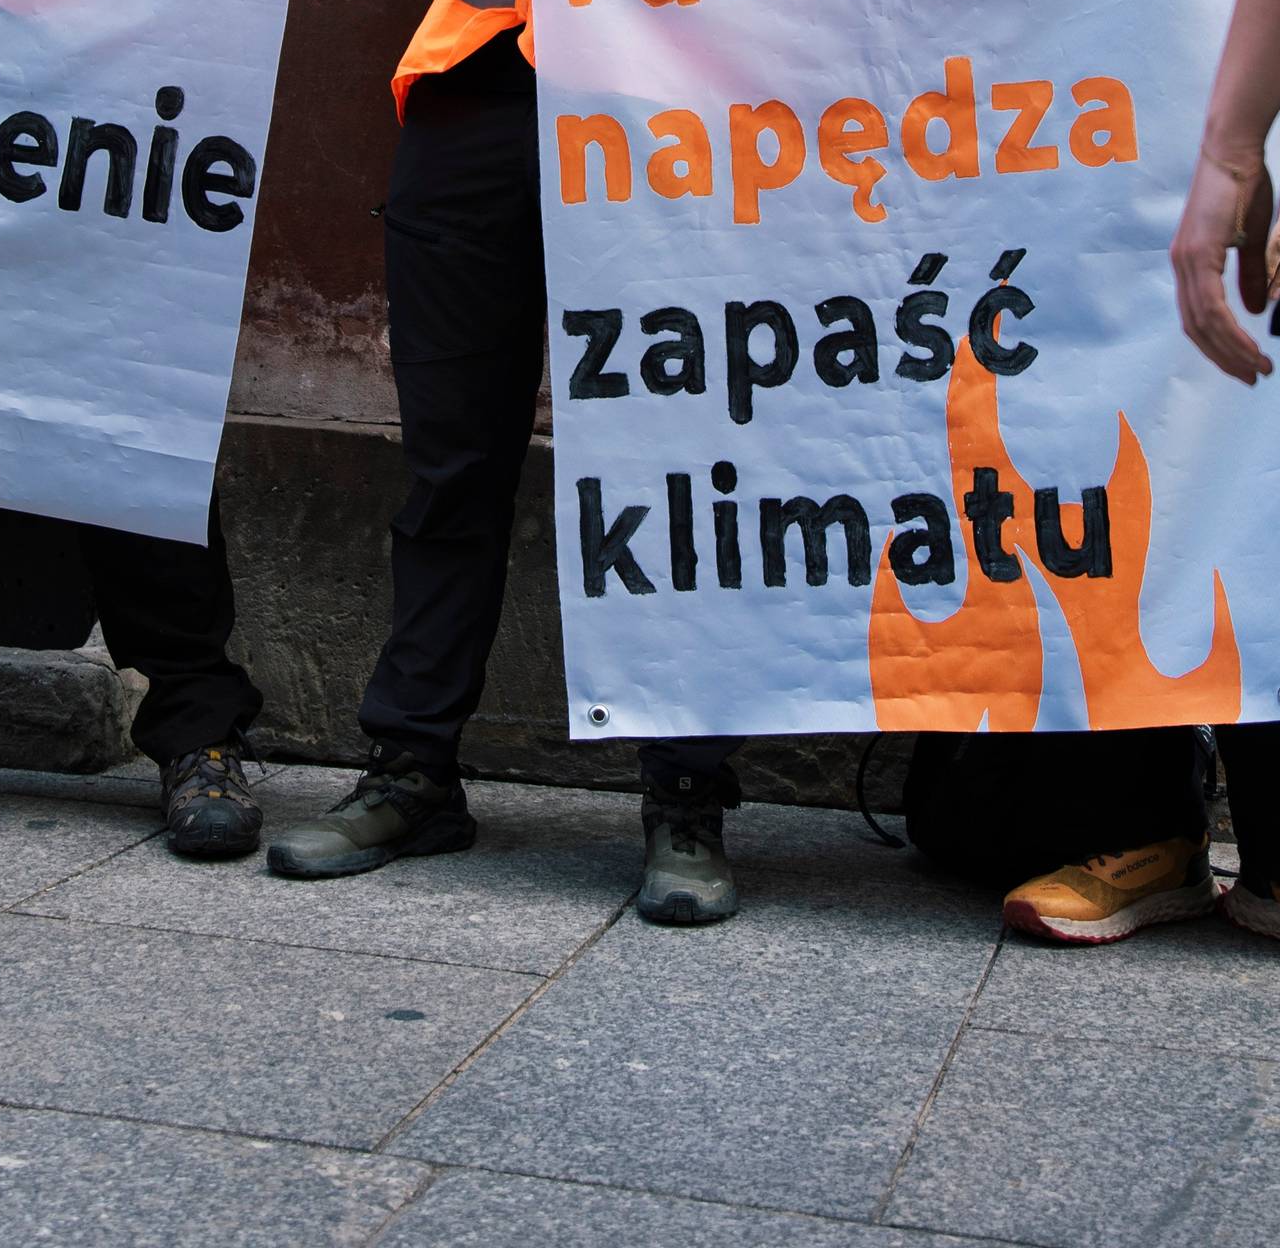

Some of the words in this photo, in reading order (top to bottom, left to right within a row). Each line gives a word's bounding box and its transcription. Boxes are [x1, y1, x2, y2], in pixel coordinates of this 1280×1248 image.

[556, 56, 1140, 224] napędza
[561, 248, 1038, 425] zapaść
[576, 461, 1114, 598] klimatu
[1111, 867, 1128, 880] new
[1128, 854, 1159, 871] balance
